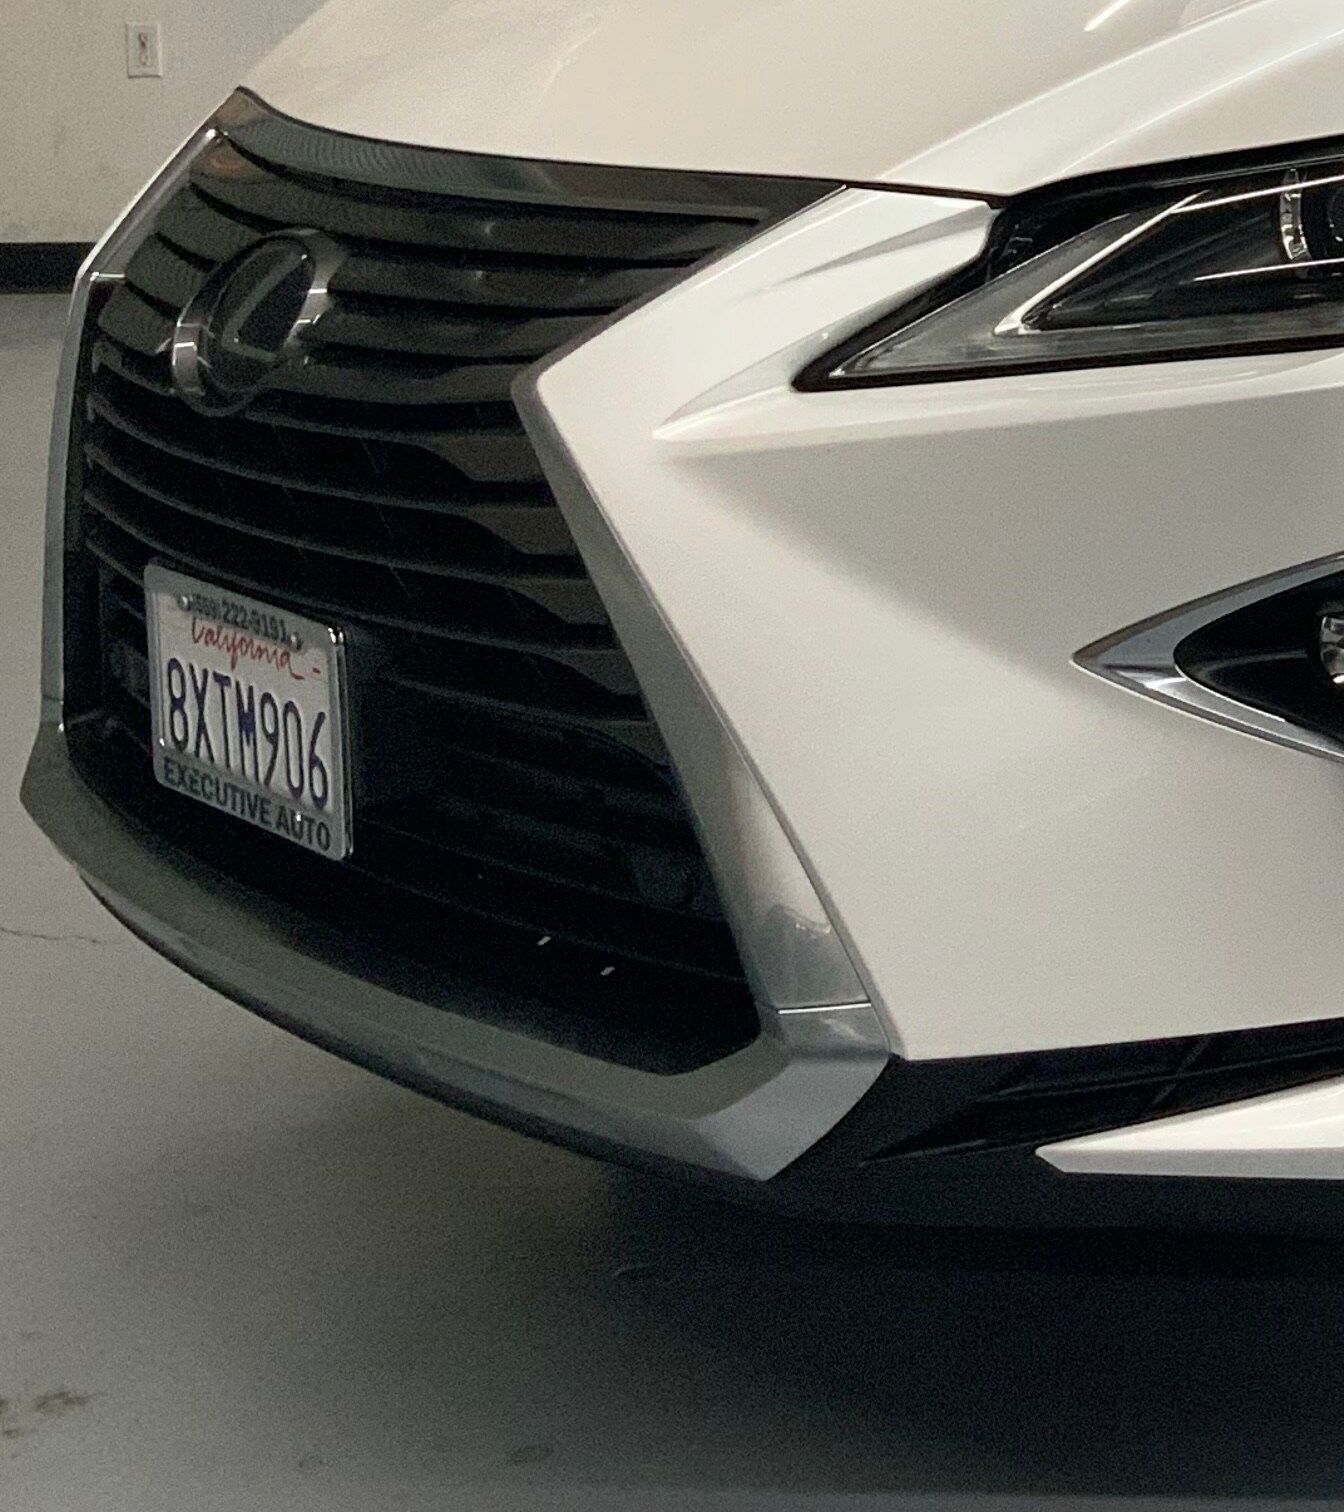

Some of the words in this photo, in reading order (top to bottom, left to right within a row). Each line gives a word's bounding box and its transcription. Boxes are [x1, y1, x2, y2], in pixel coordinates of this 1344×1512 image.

[191, 615, 304, 680] California
[167, 657, 330, 811] 8XTM906
[163, 756, 272, 826] EXECUTIVE
[275, 803, 332, 853] AUTO
